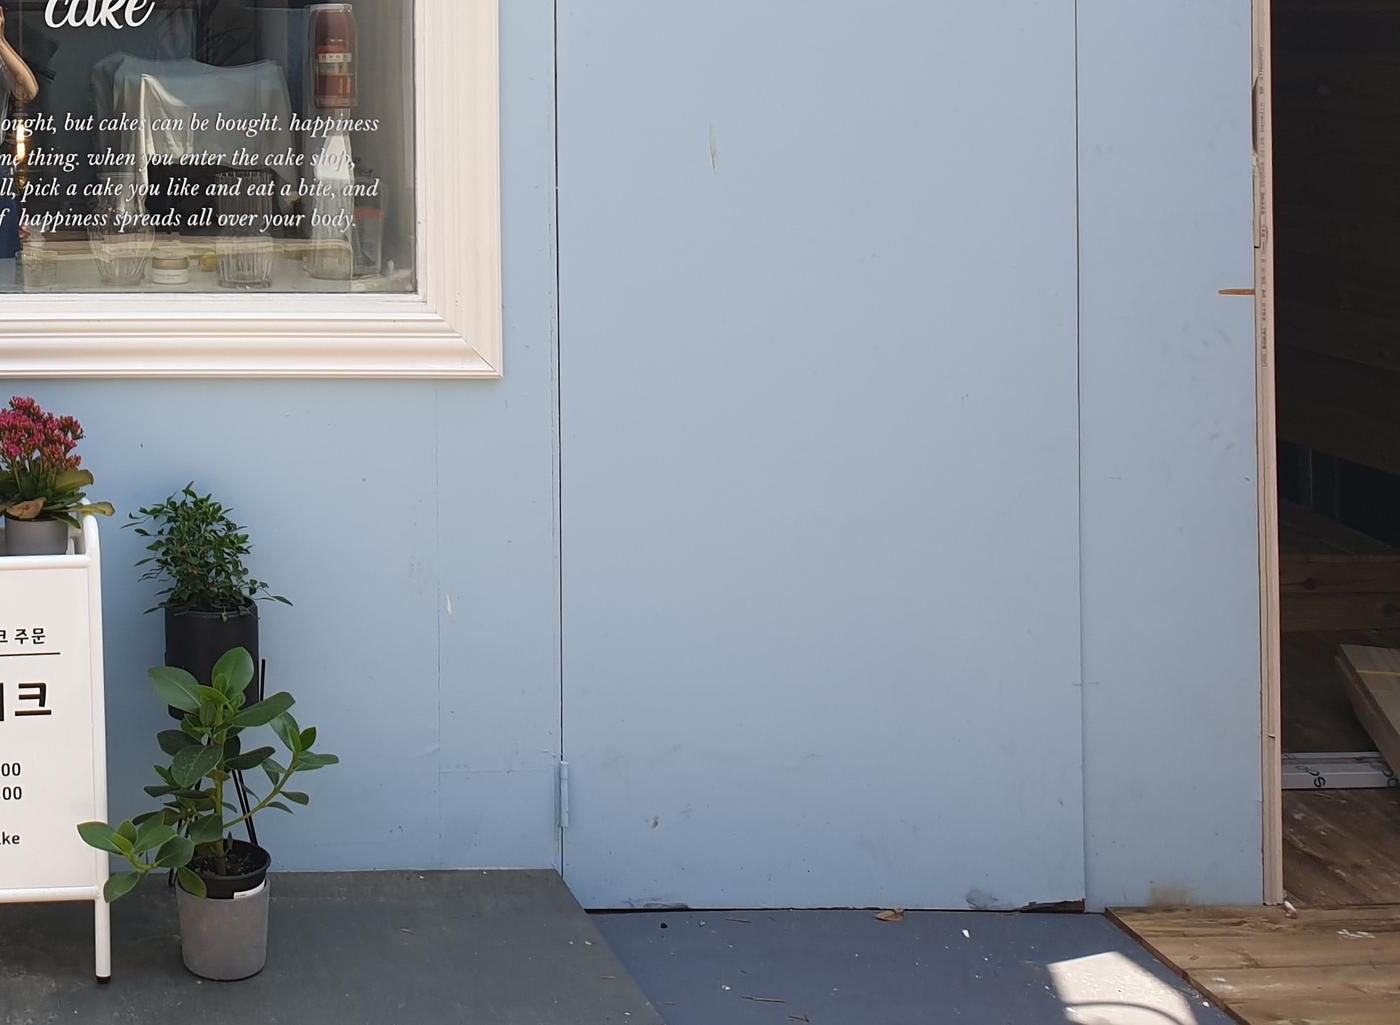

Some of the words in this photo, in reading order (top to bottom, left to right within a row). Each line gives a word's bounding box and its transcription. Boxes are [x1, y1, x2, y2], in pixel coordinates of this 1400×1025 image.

[64, 112, 94, 132] but
[98, 112, 146, 132] cakes
[151, 117, 188, 132] can
[190, 112, 210, 132] be
[215, 112, 283, 138] bought.
[289, 112, 380, 138] happiness
[27, 147, 80, 172] thing.
[87, 148, 136, 166] when
[138, 151, 174, 172] you
[179, 149, 226, 166] enter
[231, 147, 259, 166] the
[264, 147, 304, 166] cake
[21, 177, 60, 203] pick
[66, 182, 78, 196] a
[83, 177, 123, 196] cake
[126, 181, 160, 202] you
[166, 177, 199, 196] like
[205, 177, 241, 196] and
[246, 179, 275, 196] eat
[280, 181, 292, 196] a
[298, 177, 333, 199] bite,
[342, 178, 378, 196] and
[18, 208, 108, 233] happiness
[113, 208, 181, 232] spreads
[187, 208, 212, 226] all
[217, 212, 255, 226] over
[259, 212, 302, 232] your
[311, 208, 356, 232] body.
[14, 627, 47, 645] 주문
